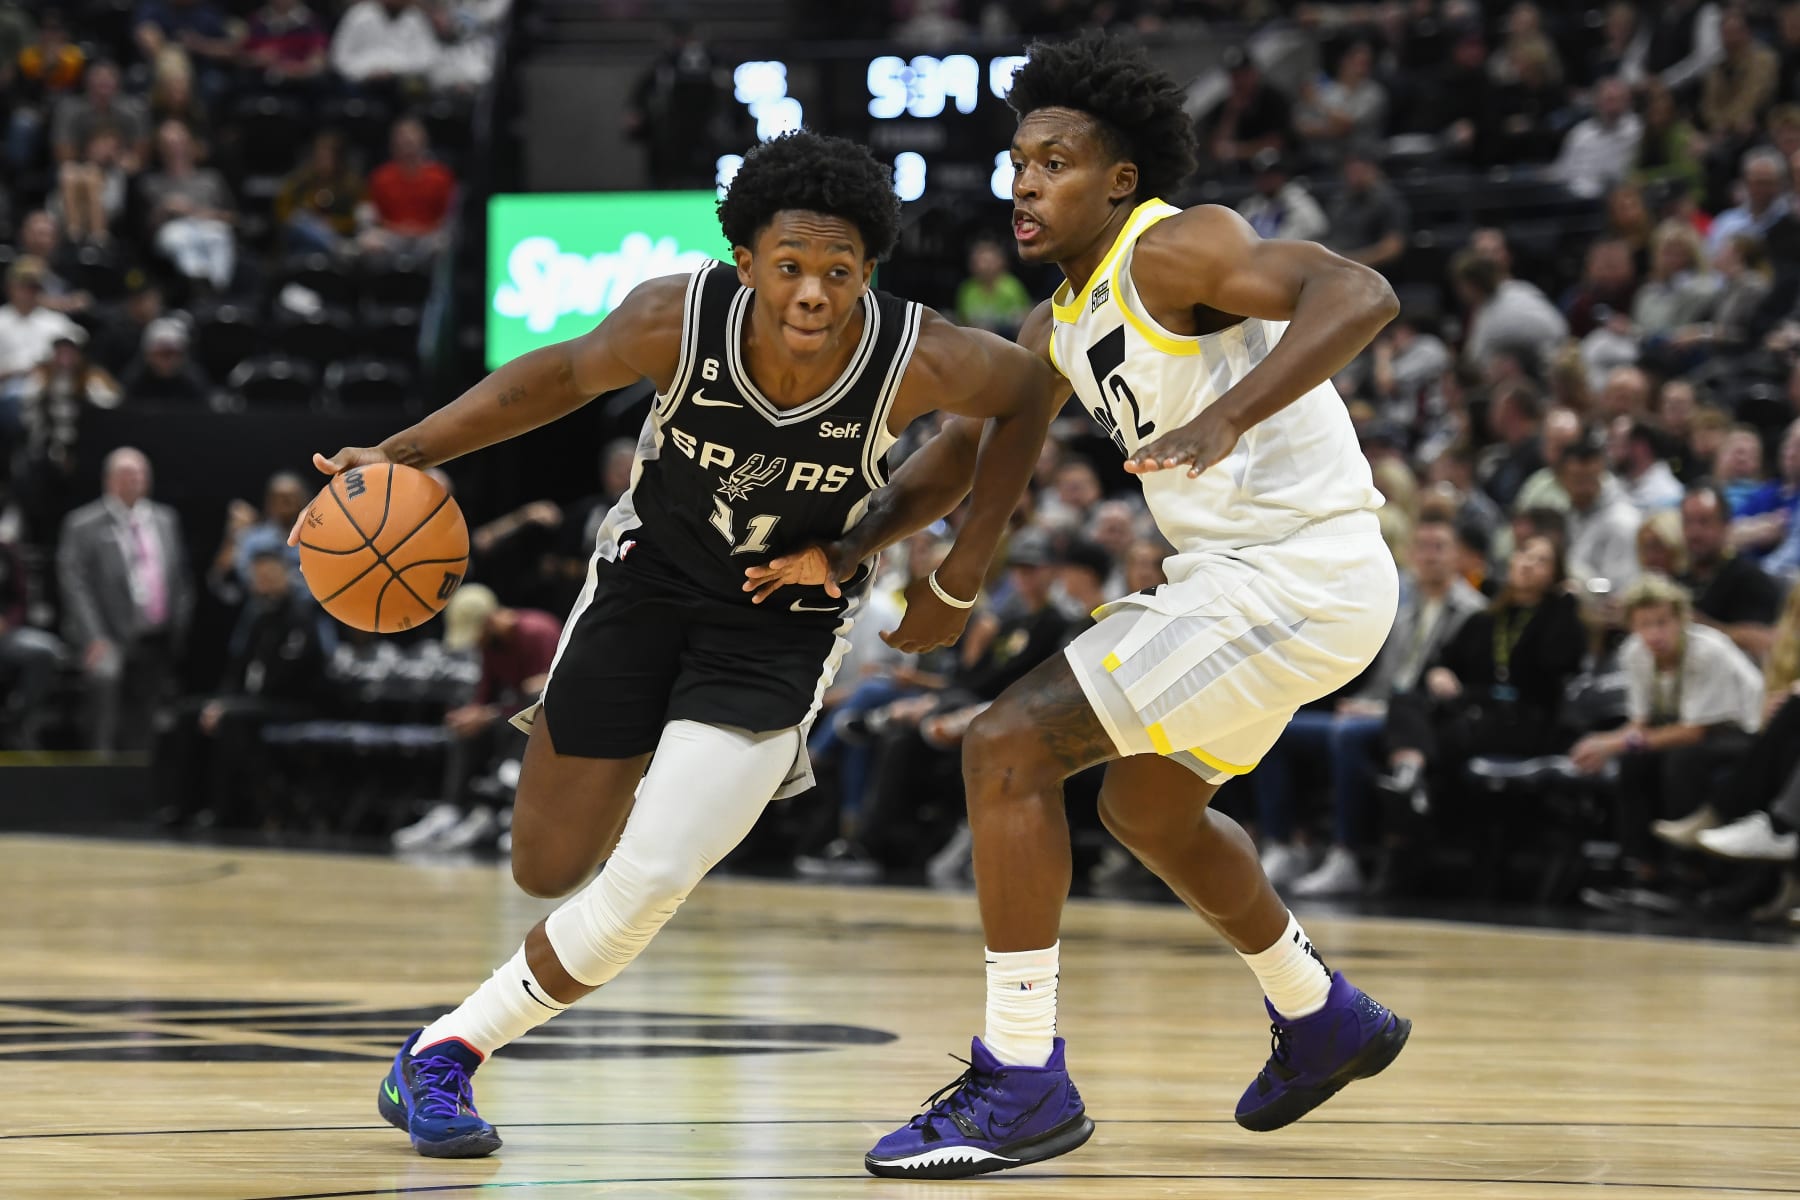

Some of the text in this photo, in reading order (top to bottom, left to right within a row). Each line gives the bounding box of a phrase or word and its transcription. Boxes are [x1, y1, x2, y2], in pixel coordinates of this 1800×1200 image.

[702, 358, 720, 382] 6
[818, 421, 861, 439] Self.
[671, 427, 854, 502] SPURS
[708, 494, 781, 556] 11
